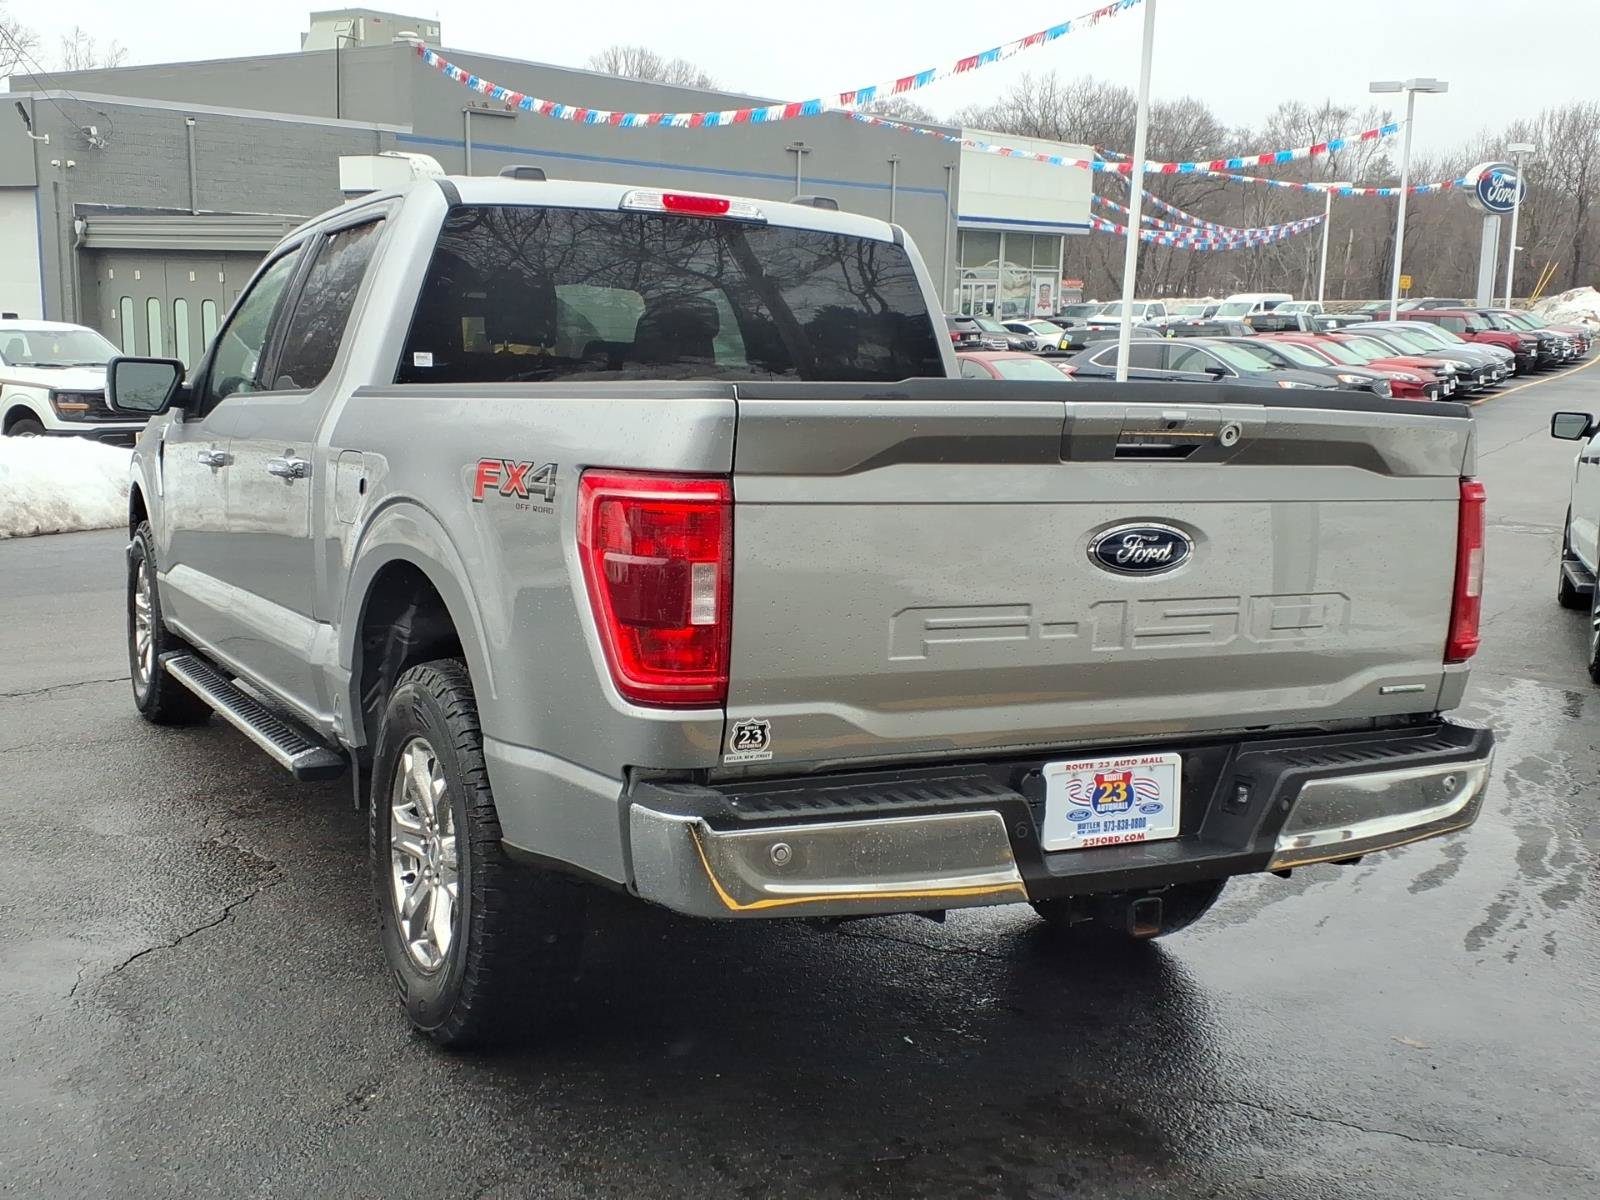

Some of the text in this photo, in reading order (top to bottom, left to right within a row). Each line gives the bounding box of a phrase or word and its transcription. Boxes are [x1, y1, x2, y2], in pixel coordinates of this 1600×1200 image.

[472, 457, 558, 503] FX4
[515, 503, 554, 514] OFF ROAD
[1116, 534, 1173, 563] Ford
[888, 591, 1352, 661] F-150
[739, 729, 762, 744] 23
[1065, 757, 1164, 771] ROUTE 23 AUTO MALL
[1098, 781, 1128, 803] 23
[1083, 833, 1145, 846] 23FORD.COM
